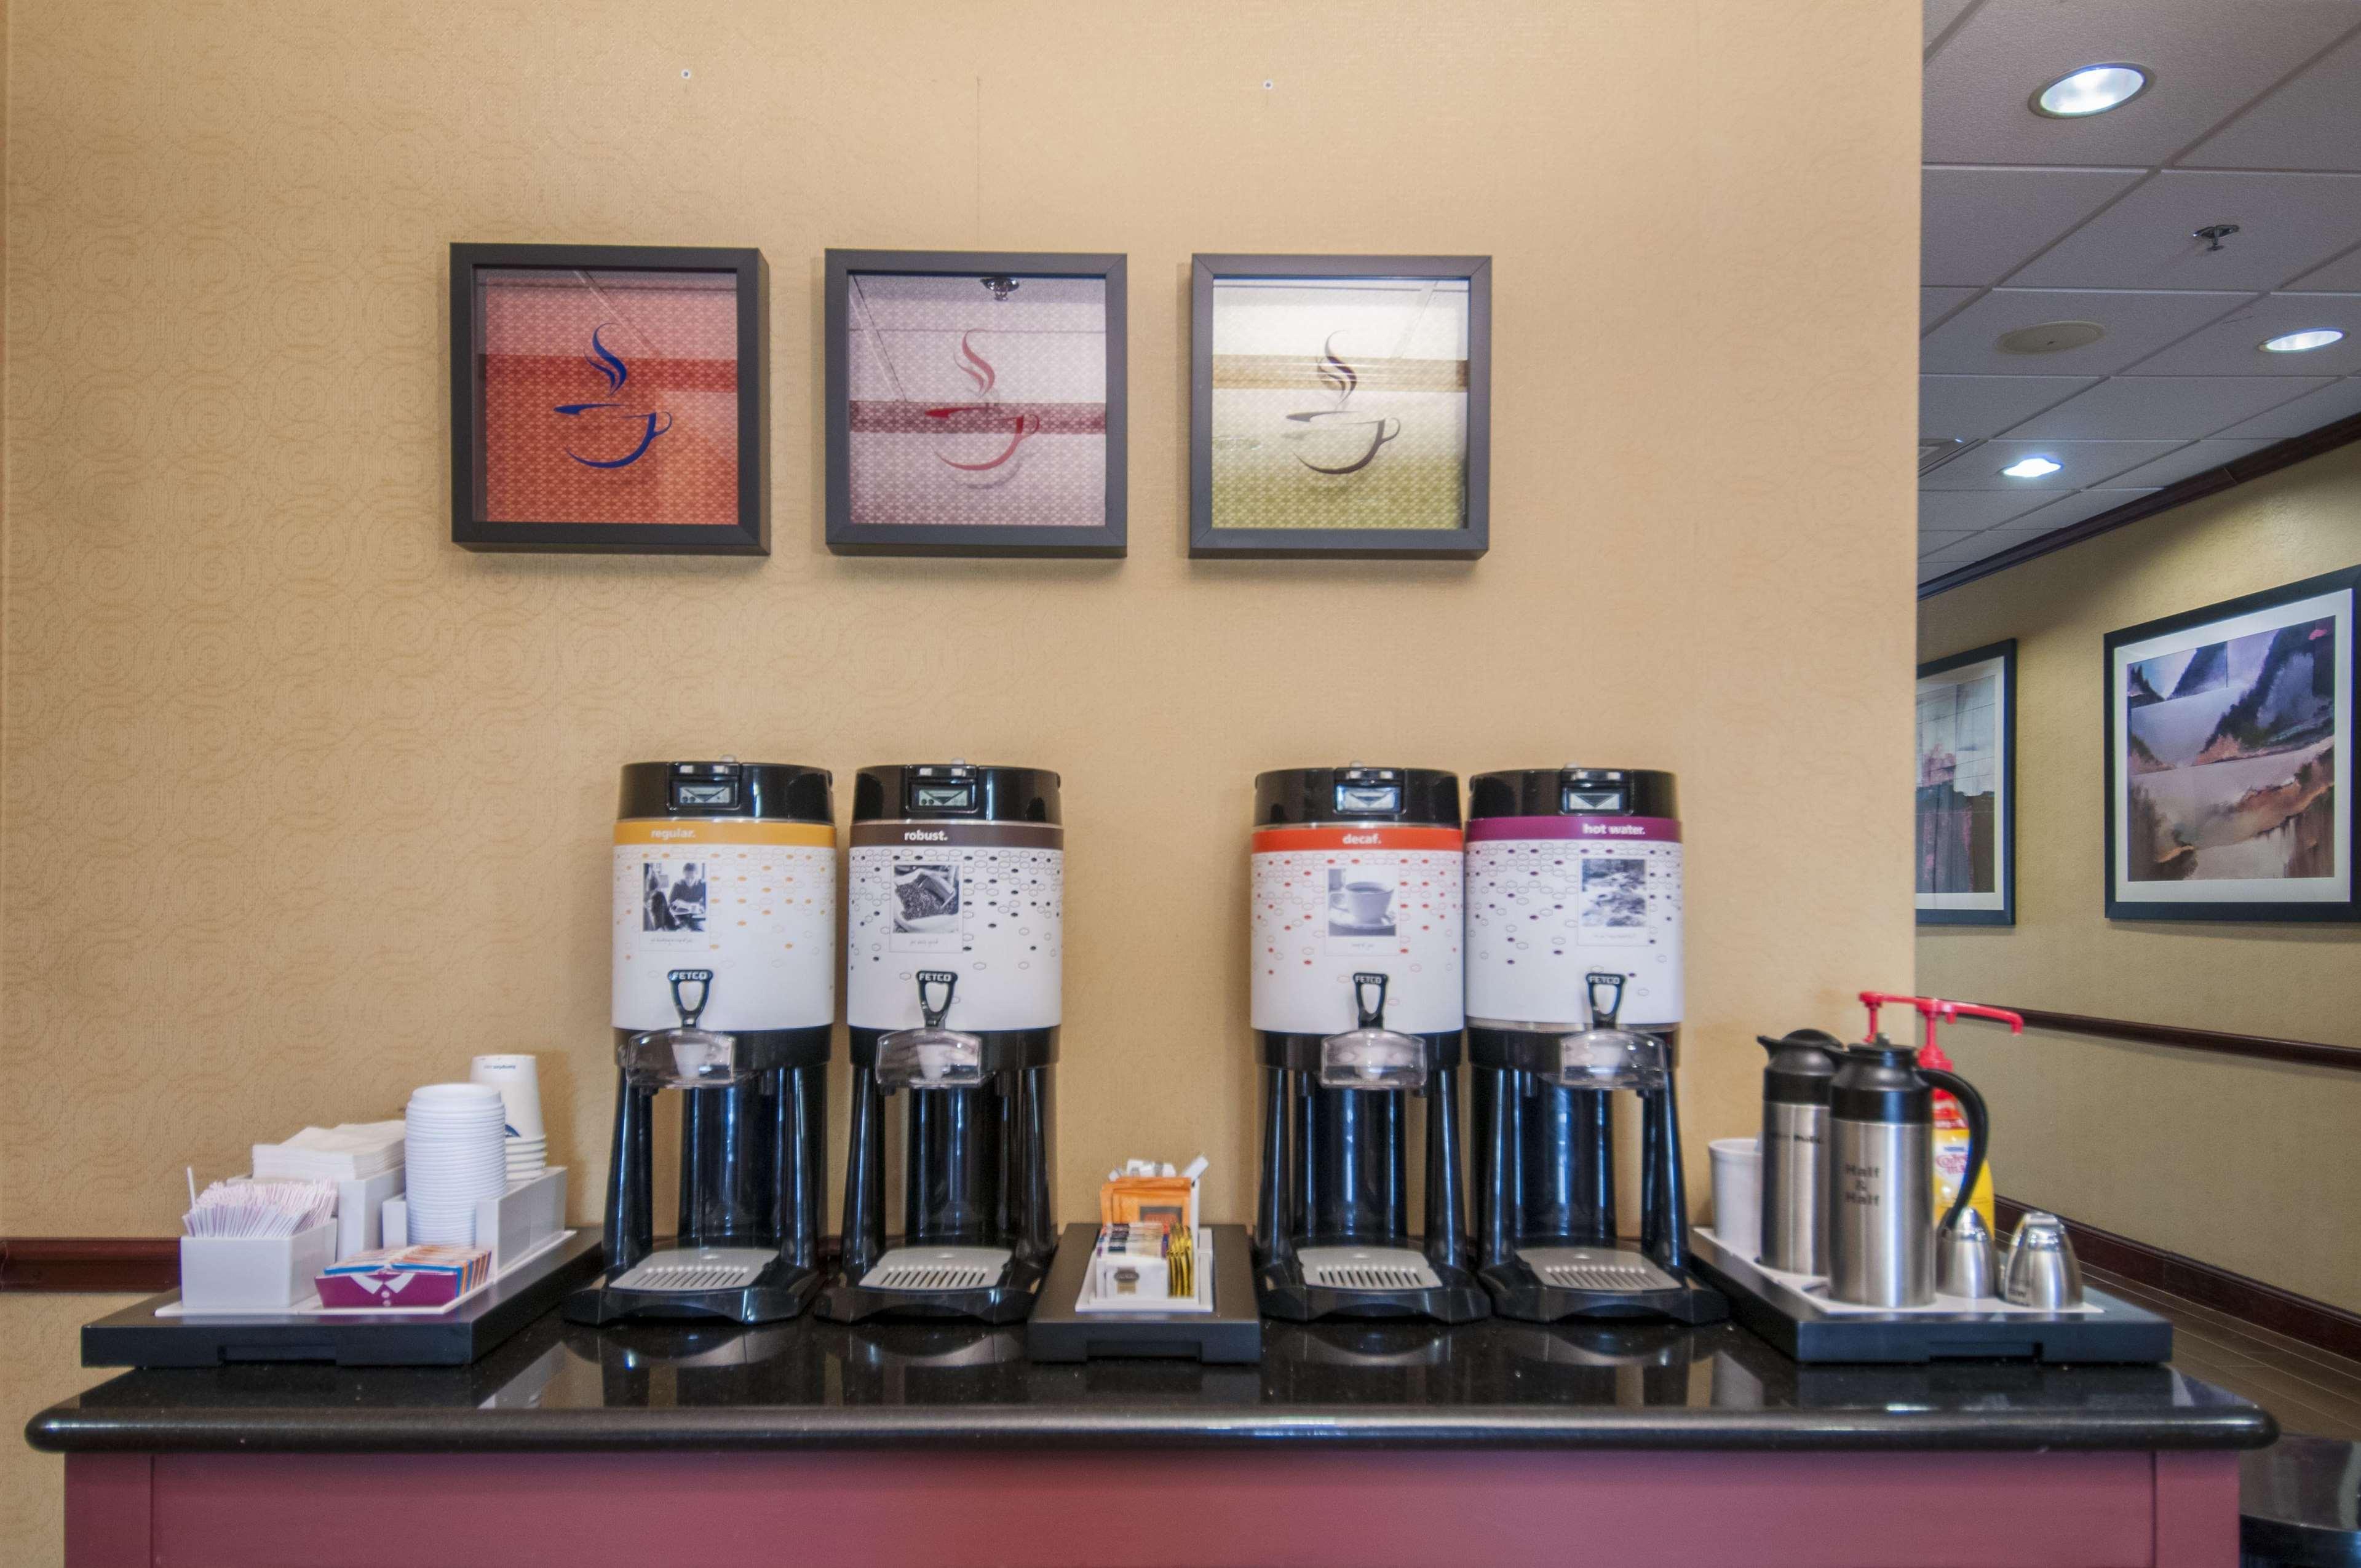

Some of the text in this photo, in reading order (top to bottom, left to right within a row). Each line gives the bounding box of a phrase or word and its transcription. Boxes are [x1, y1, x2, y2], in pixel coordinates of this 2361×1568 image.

[651, 828, 696, 840] regular.
[904, 829, 948, 841] robust.
[1582, 823, 1646, 835] hot water.
[1343, 833, 1382, 845] decaf.
[671, 972, 708, 981] FETCO
[919, 973, 952, 982] FETCO
[1588, 975, 1621, 984] FETCO
